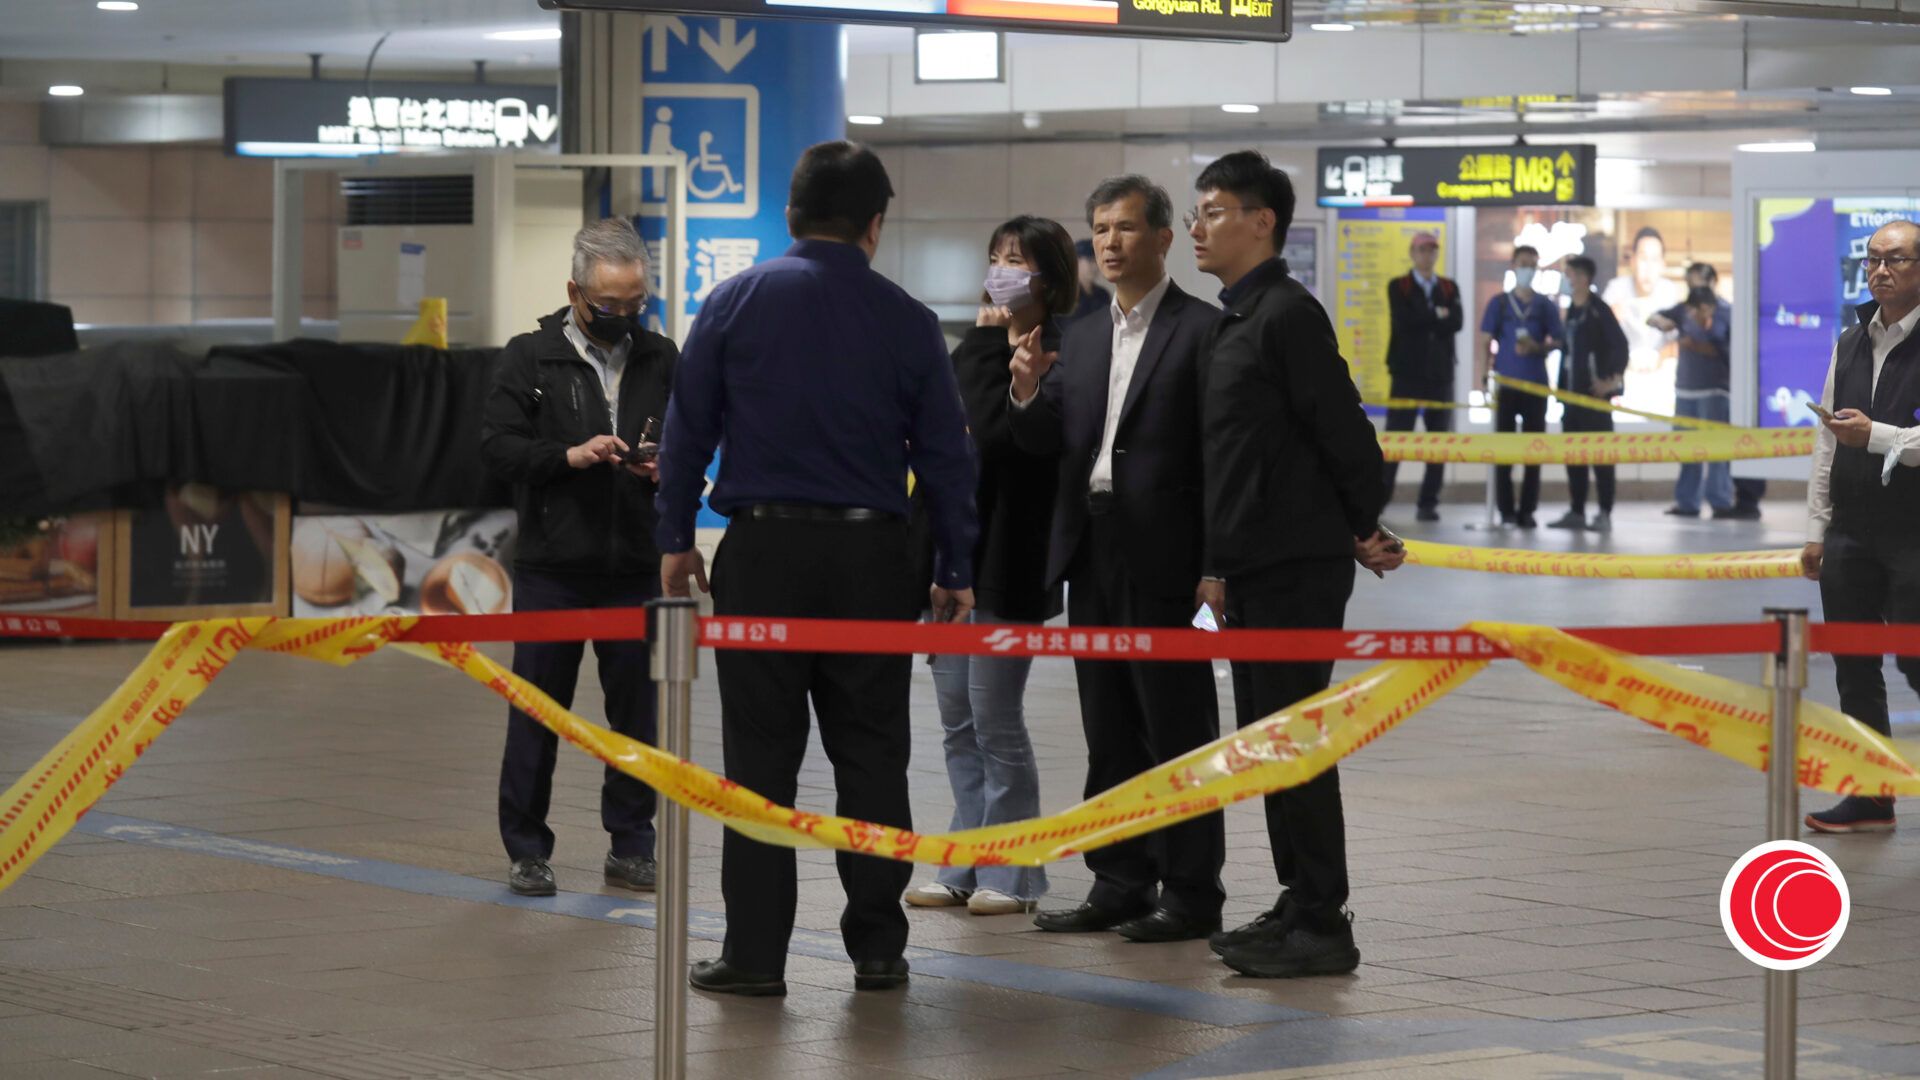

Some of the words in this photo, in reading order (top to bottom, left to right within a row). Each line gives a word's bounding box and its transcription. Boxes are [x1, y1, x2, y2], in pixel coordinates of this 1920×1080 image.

[1252, 2, 1273, 17] EXIT
[1515, 156, 1555, 193] M8
[181, 523, 219, 555] NY
[1026, 632, 1152, 653] 台北捷運公司
